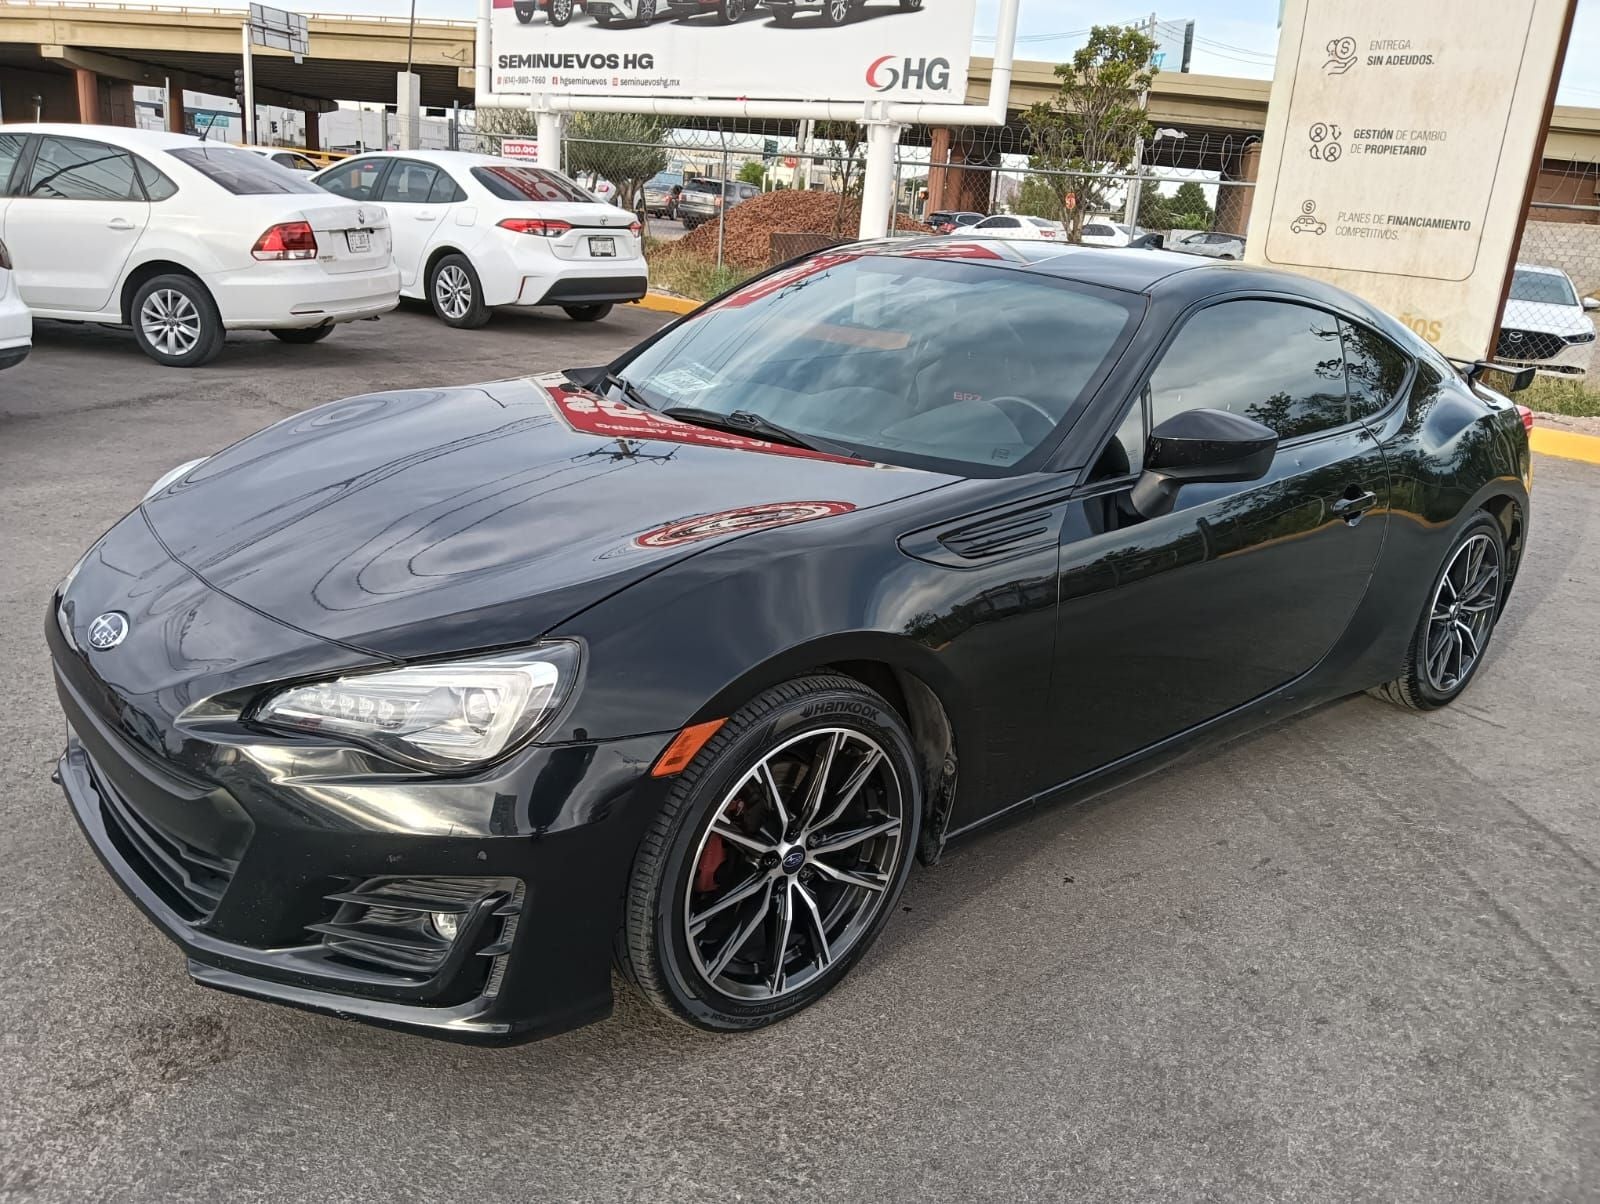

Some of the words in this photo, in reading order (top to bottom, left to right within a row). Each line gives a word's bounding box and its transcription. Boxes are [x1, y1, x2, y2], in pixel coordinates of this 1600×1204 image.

[498, 53, 620, 69] SEMINUEVOS
[623, 53, 654, 69] HG
[1367, 56, 1384, 65] SIN
[1385, 55, 1435, 65] ADEUDOS.
[901, 57, 950, 90] HG
[559, 77, 607, 86] hgseminuevos
[620, 77, 680, 88] seminuevoshg.mx
[1353, 128, 1393, 139] GESTIÓN
[1395, 130, 1408, 140] DE
[1410, 130, 1447, 141] CAMBIO
[1350, 143, 1362, 153] DE
[1364, 144, 1427, 156] PROPIETARIO
[1337, 212, 1371, 224] PLANES
[1372, 214, 1385, 224] DE
[1386, 215, 1471, 231] FINANCIAMIENTO
[1335, 226, 1399, 240] COMPETITIVOS.
